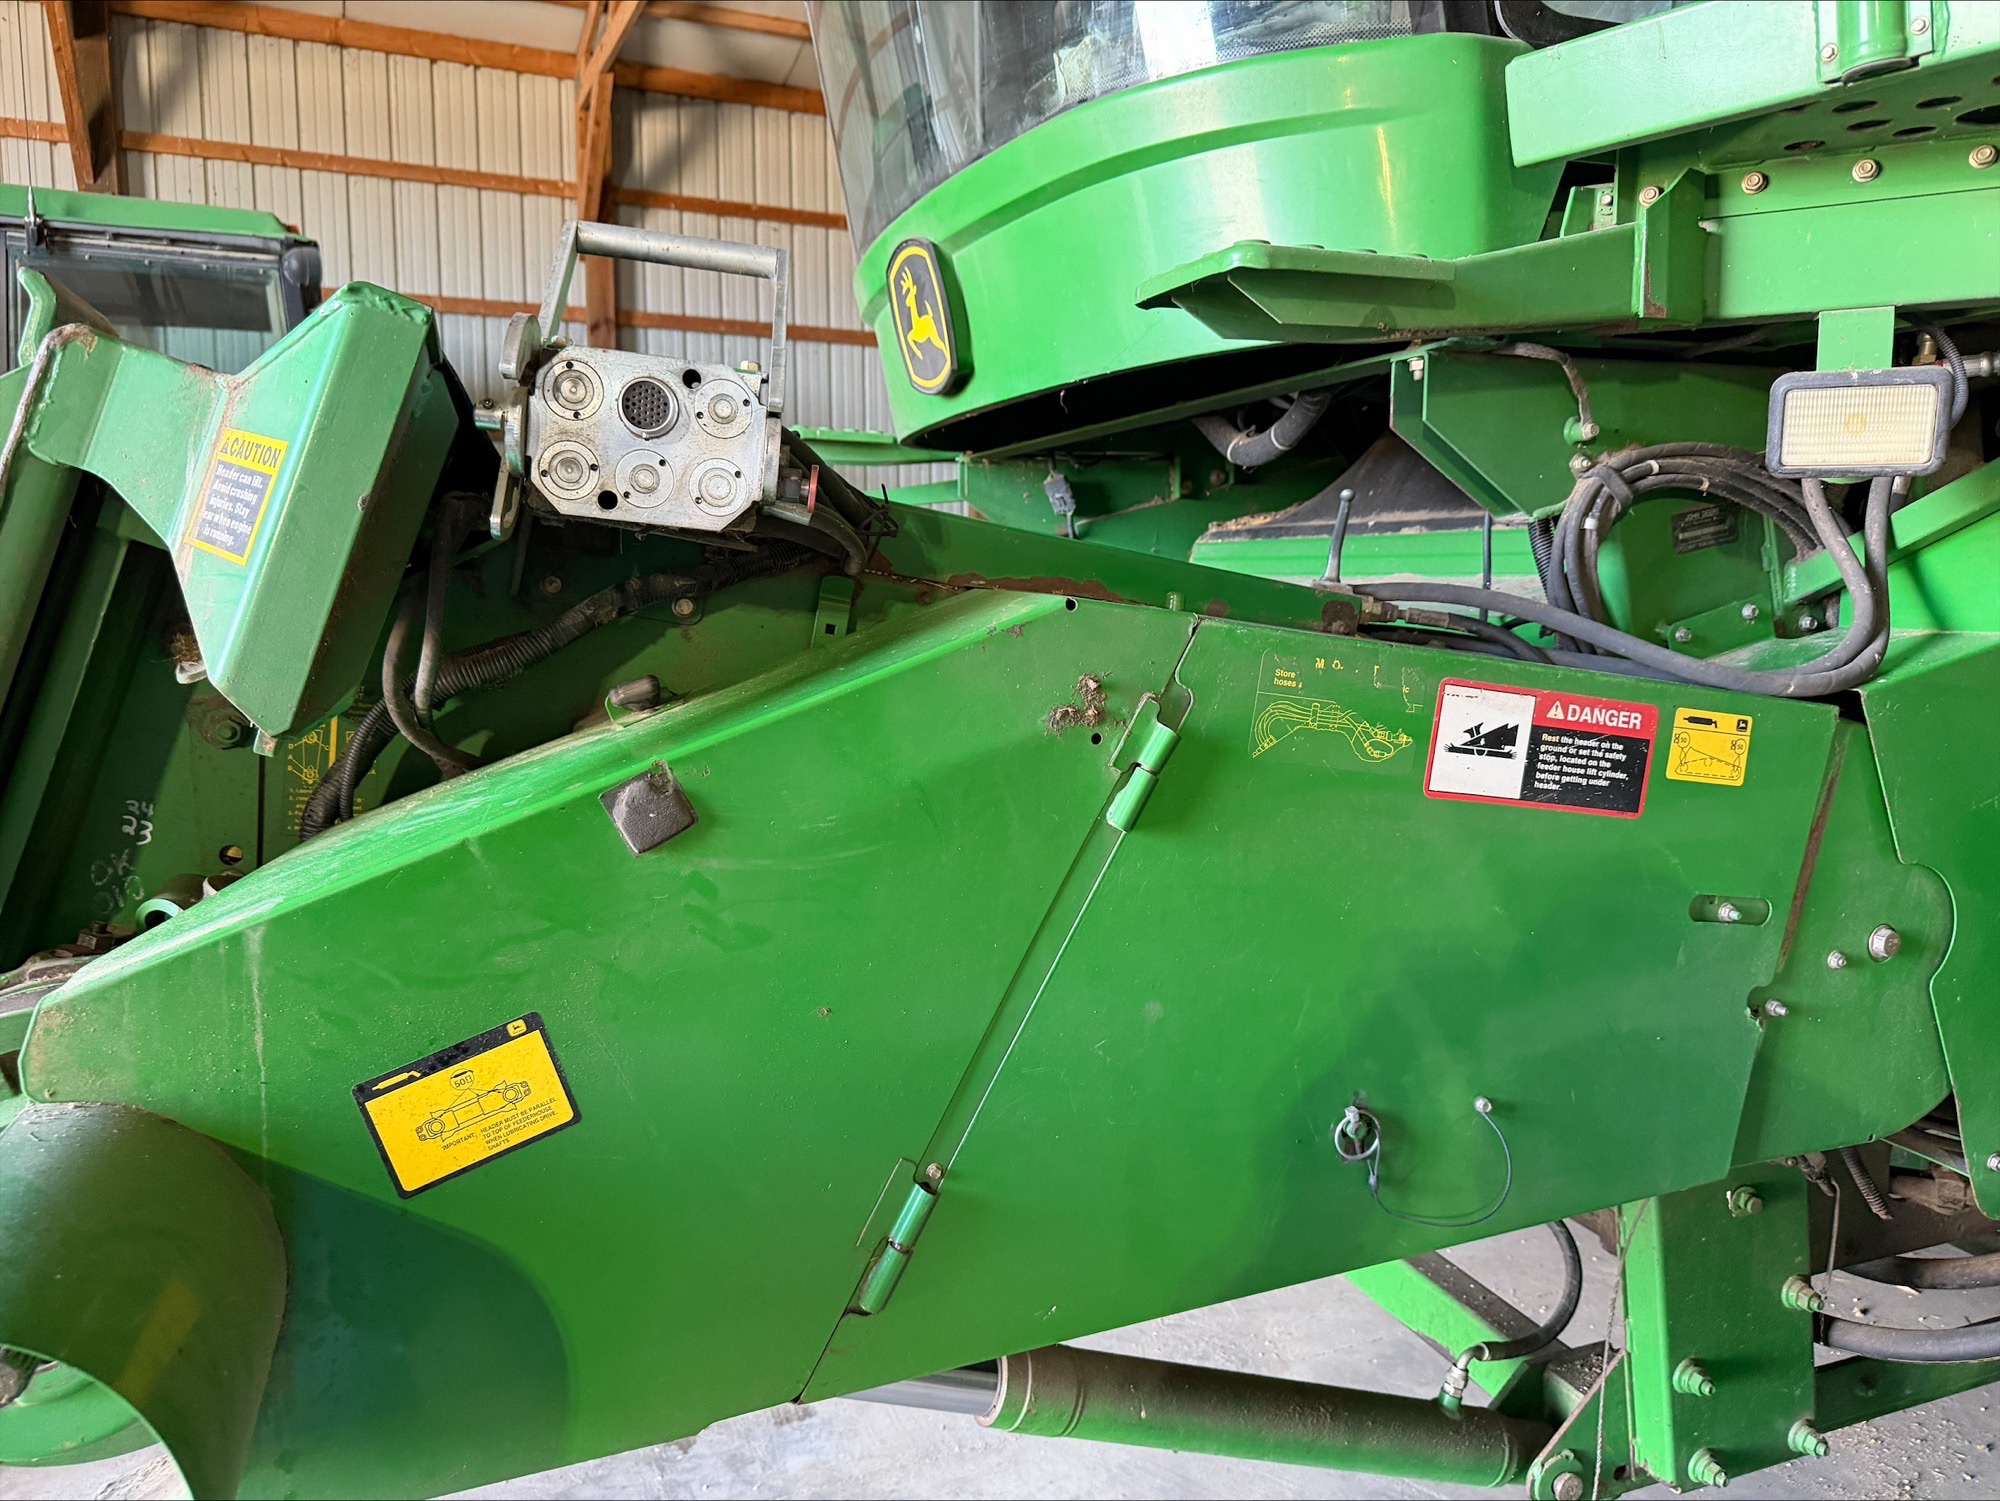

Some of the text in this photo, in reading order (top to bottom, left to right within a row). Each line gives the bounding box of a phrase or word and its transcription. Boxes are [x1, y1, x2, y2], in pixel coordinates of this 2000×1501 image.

[230, 437, 282, 469] CAUTION
[215, 464, 240, 481] Header
[239, 474, 252, 485] can
[212, 480, 258, 505] Avoid crushing
[234, 501, 250, 519] Stay
[212, 511, 231, 528] when
[230, 520, 252, 535] engine
[1274, 678, 1297, 688] hoses
[1275, 668, 1296, 679] Store
[1567, 704, 1642, 730] DANGER
[1542, 733, 1560, 743] Rest
[1561, 736, 1573, 744] the
[1574, 737, 1599, 748] header
[1612, 742, 1624, 751] the
[1680, 736, 1687, 744] 50
[1539, 753, 1558, 763] stop,
[1559, 755, 1587, 765] located
[1599, 759, 1611, 769] the
[1540, 744, 1568, 754] ground
[1578, 748, 1590, 757] set
[1591, 749, 1604, 758] the
[1604, 752, 1627, 763] safety
[1535, 772, 1610, 787] before getting under
[1537, 762, 1629, 781] feeder house lift cylinder,
[1534, 781, 1562, 791] header.
[121, 815, 154, 846] 23
[480, 1120, 503, 1134] HEADER
[504, 1113, 520, 1123] MUST
[528, 1097, 557, 1113] PARALLEL
[482, 1106, 553, 1140] TO TOP OF FEEDERHOUSE
[485, 1134, 503, 1145] WHEN
[502, 1118, 540, 1139] LUBRICATING
[487, 1138, 510, 1151] SHAFTS
